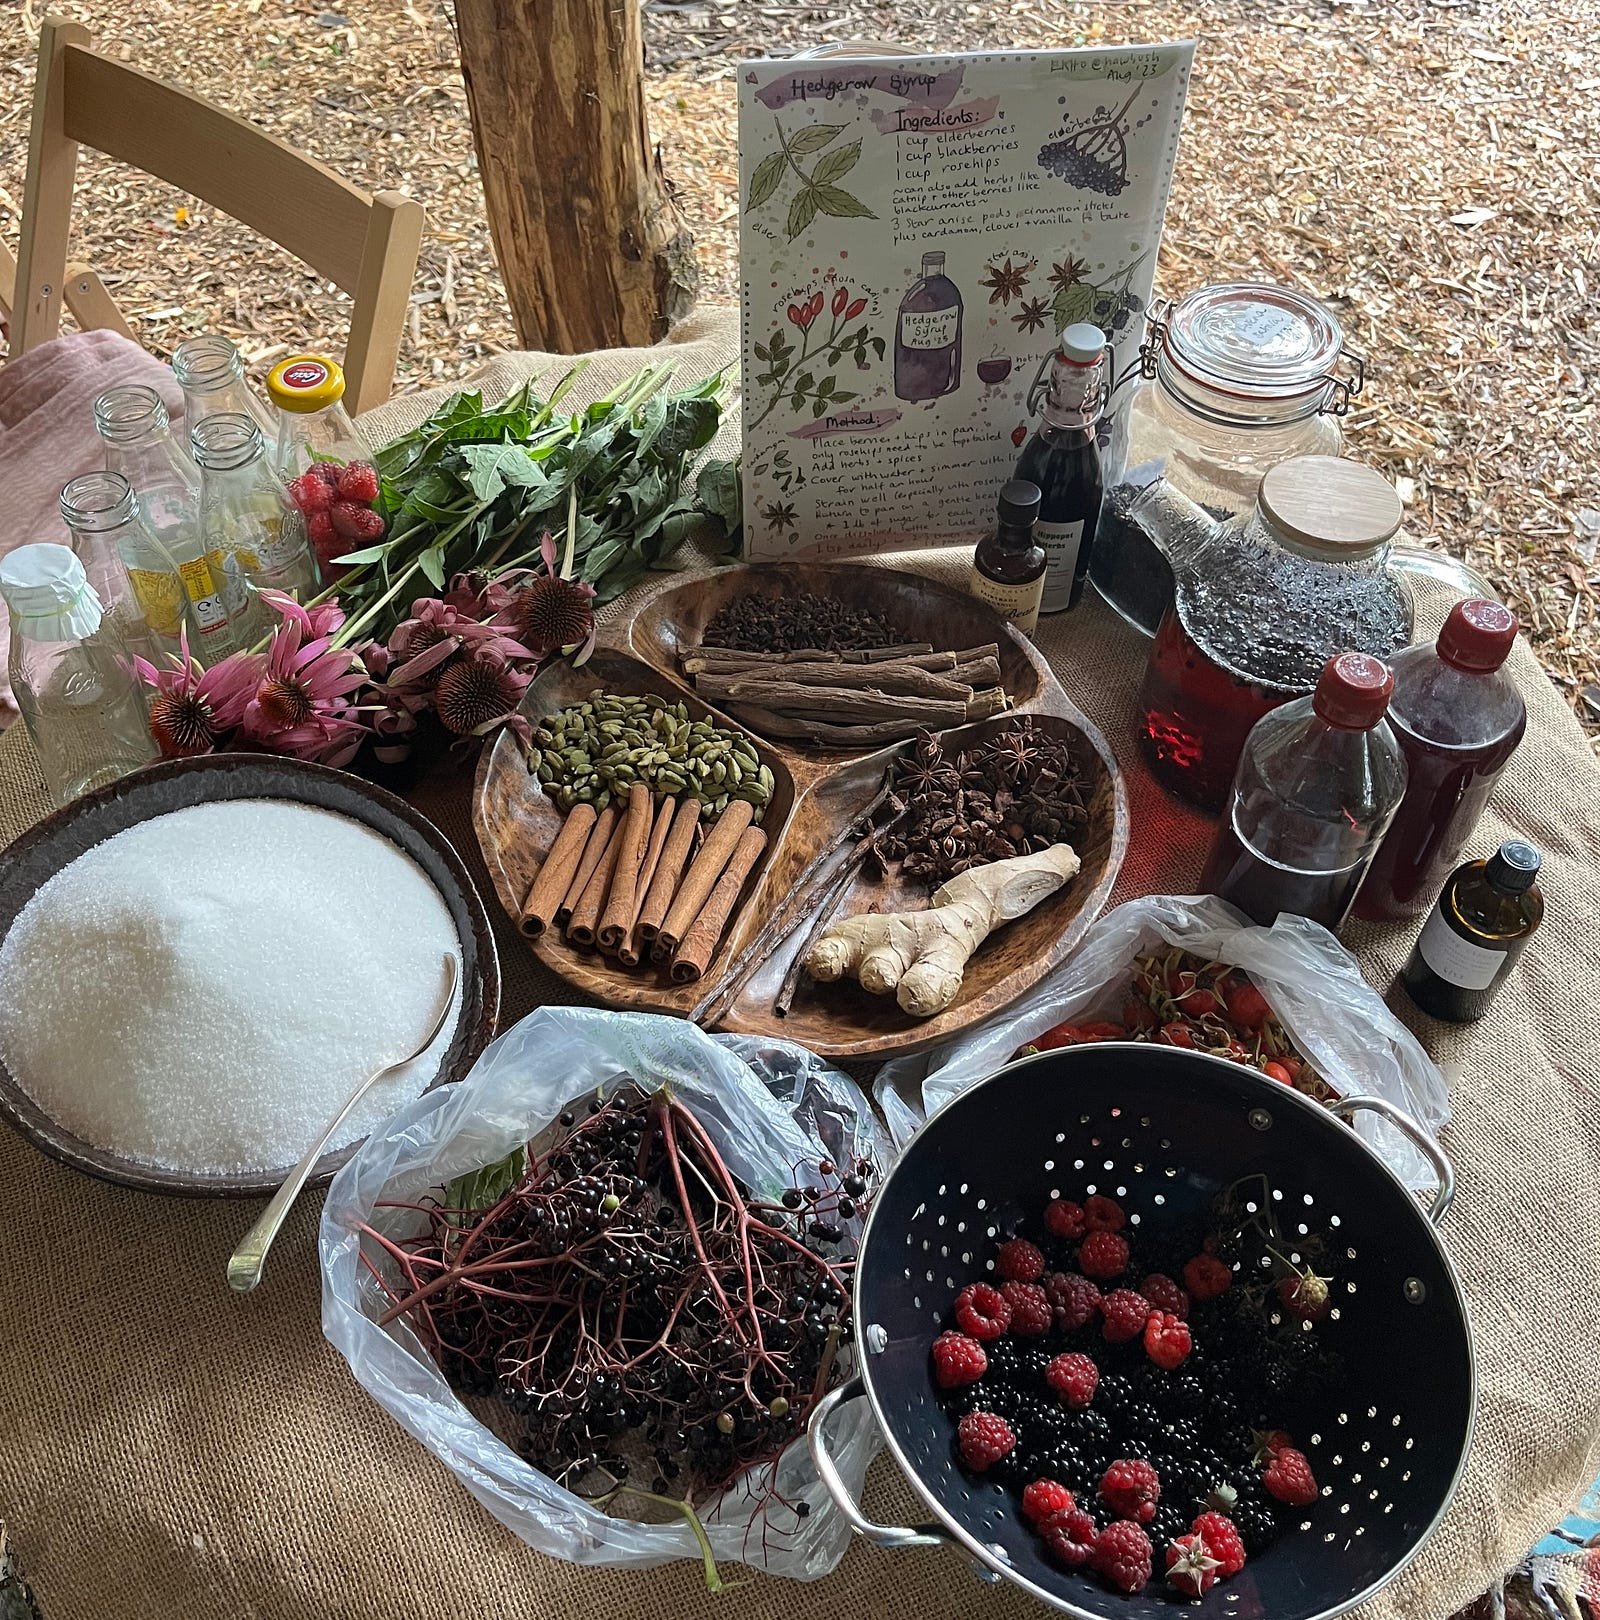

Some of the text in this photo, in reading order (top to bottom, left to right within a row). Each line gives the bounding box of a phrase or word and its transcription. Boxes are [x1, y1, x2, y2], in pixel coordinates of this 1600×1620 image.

[791, 75, 936, 102] Hedgerow Syrup
[895, 109, 980, 131] Ingredients:
[906, 137, 929, 152] cup
[936, 124, 1016, 143] elderberries
[906, 151, 932, 165] cup
[938, 139, 1019, 159] blackberries
[905, 169, 931, 183] cup
[941, 157, 1000, 174] rosehips
[928, 182, 951, 192] also
[954, 177, 978, 189] add
[984, 174, 1014, 185] herbs
[1020, 171, 1040, 181] like
[892, 195, 927, 206] catnip
[942, 191, 969, 199] other
[972, 185, 1012, 197] berries
[1017, 182, 1040, 192] like
[938, 215, 973, 226] anise
[1024, 205, 1080, 215] cinnamon
[1084, 200, 1114, 211] sticks
[752, 223, 777, 239] elder
[893, 232, 916, 246] plus
[1100, 211, 1131, 221] taste
[905, 311, 957, 327] Hedgerow
[914, 324, 947, 338] Syrup
[911, 338, 931, 347] Aug
[826, 412, 880, 428] Method:
[812, 437, 845, 448] Place
[904, 431, 931, 444] hips
[812, 451, 834, 461] only
[839, 447, 882, 457] rosehips
[886, 444, 910, 452] need
[915, 441, 928, 450] to
[811, 475, 845, 484] Cover
[851, 472, 877, 481] with
[879, 469, 914, 479] water
[931, 461, 976, 472] simmer
[980, 455, 1005, 465] with
[812, 460, 835, 471] Add
[840, 458, 870, 468] herbs
[888, 455, 922, 467] spices
[837, 487, 855, 497] for
[861, 481, 885, 490] half
[908, 476, 935, 485] hour
[815, 499, 855, 509] Strain
[861, 493, 887, 503] well
[874, 506, 895, 516] pan
[939, 496, 972, 508] gentle
[947, 508, 973, 517] each
